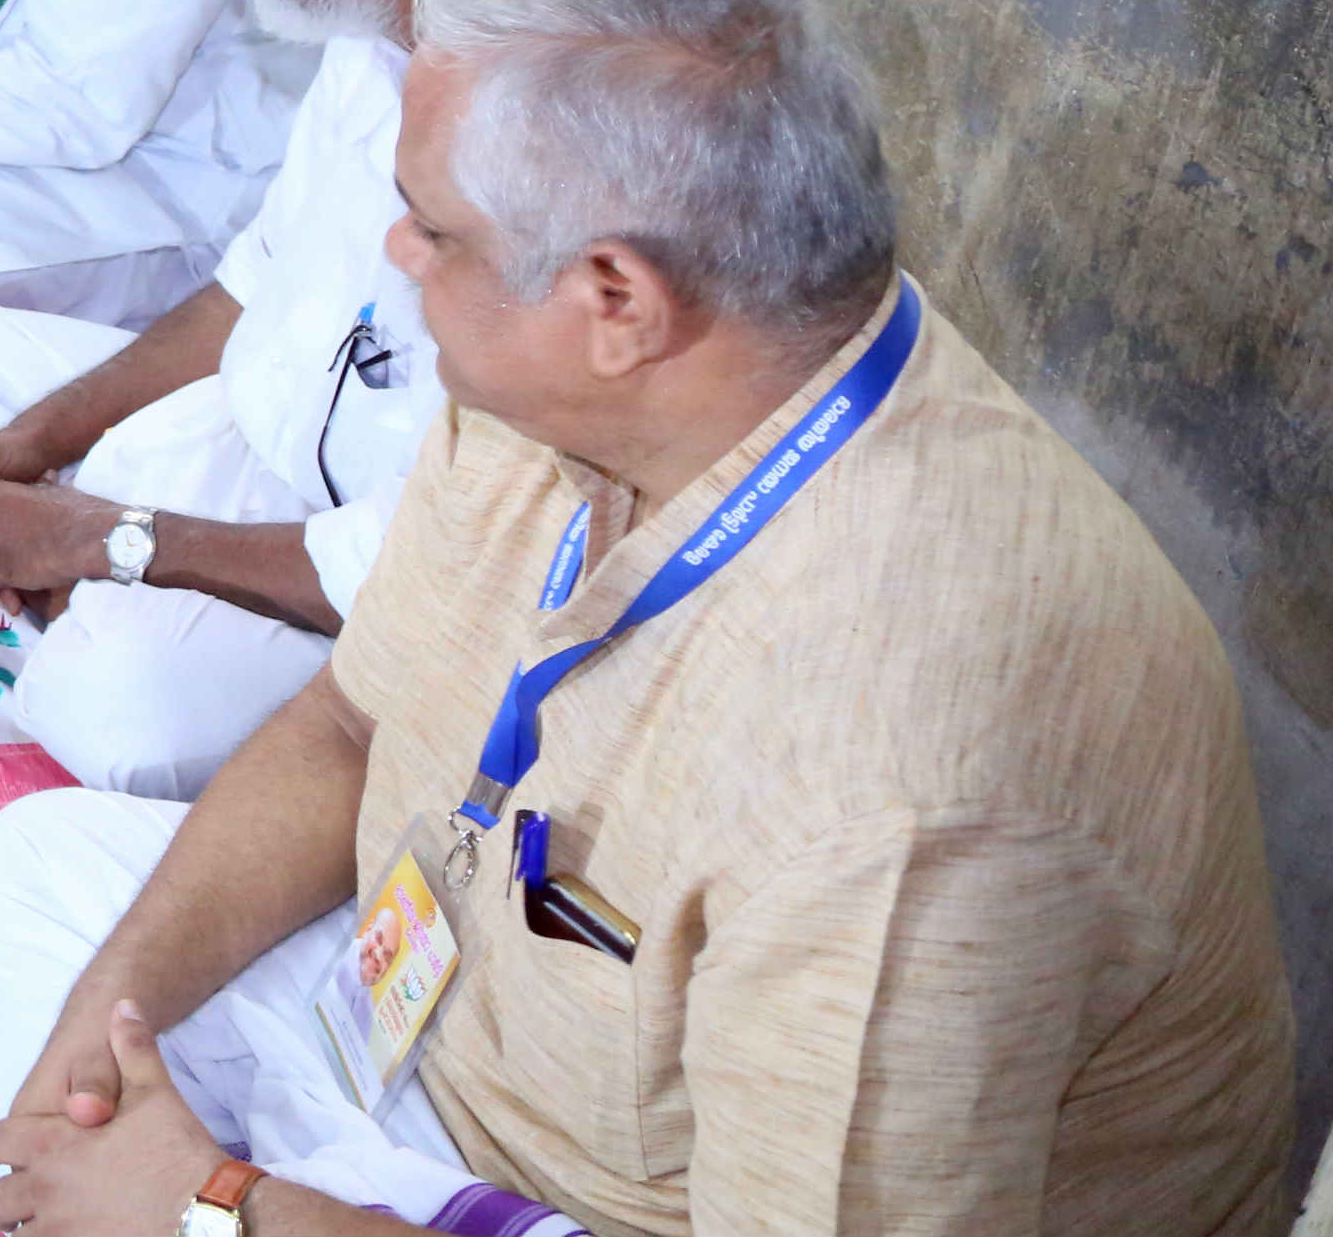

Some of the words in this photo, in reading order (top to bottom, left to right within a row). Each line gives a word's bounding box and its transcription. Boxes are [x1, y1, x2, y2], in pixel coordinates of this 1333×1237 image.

[796, 395, 851, 453] ഭാരതീയ
[756, 448, 801, 495] ജനതാ
[720, 490, 759, 534] പാർട്ടി
